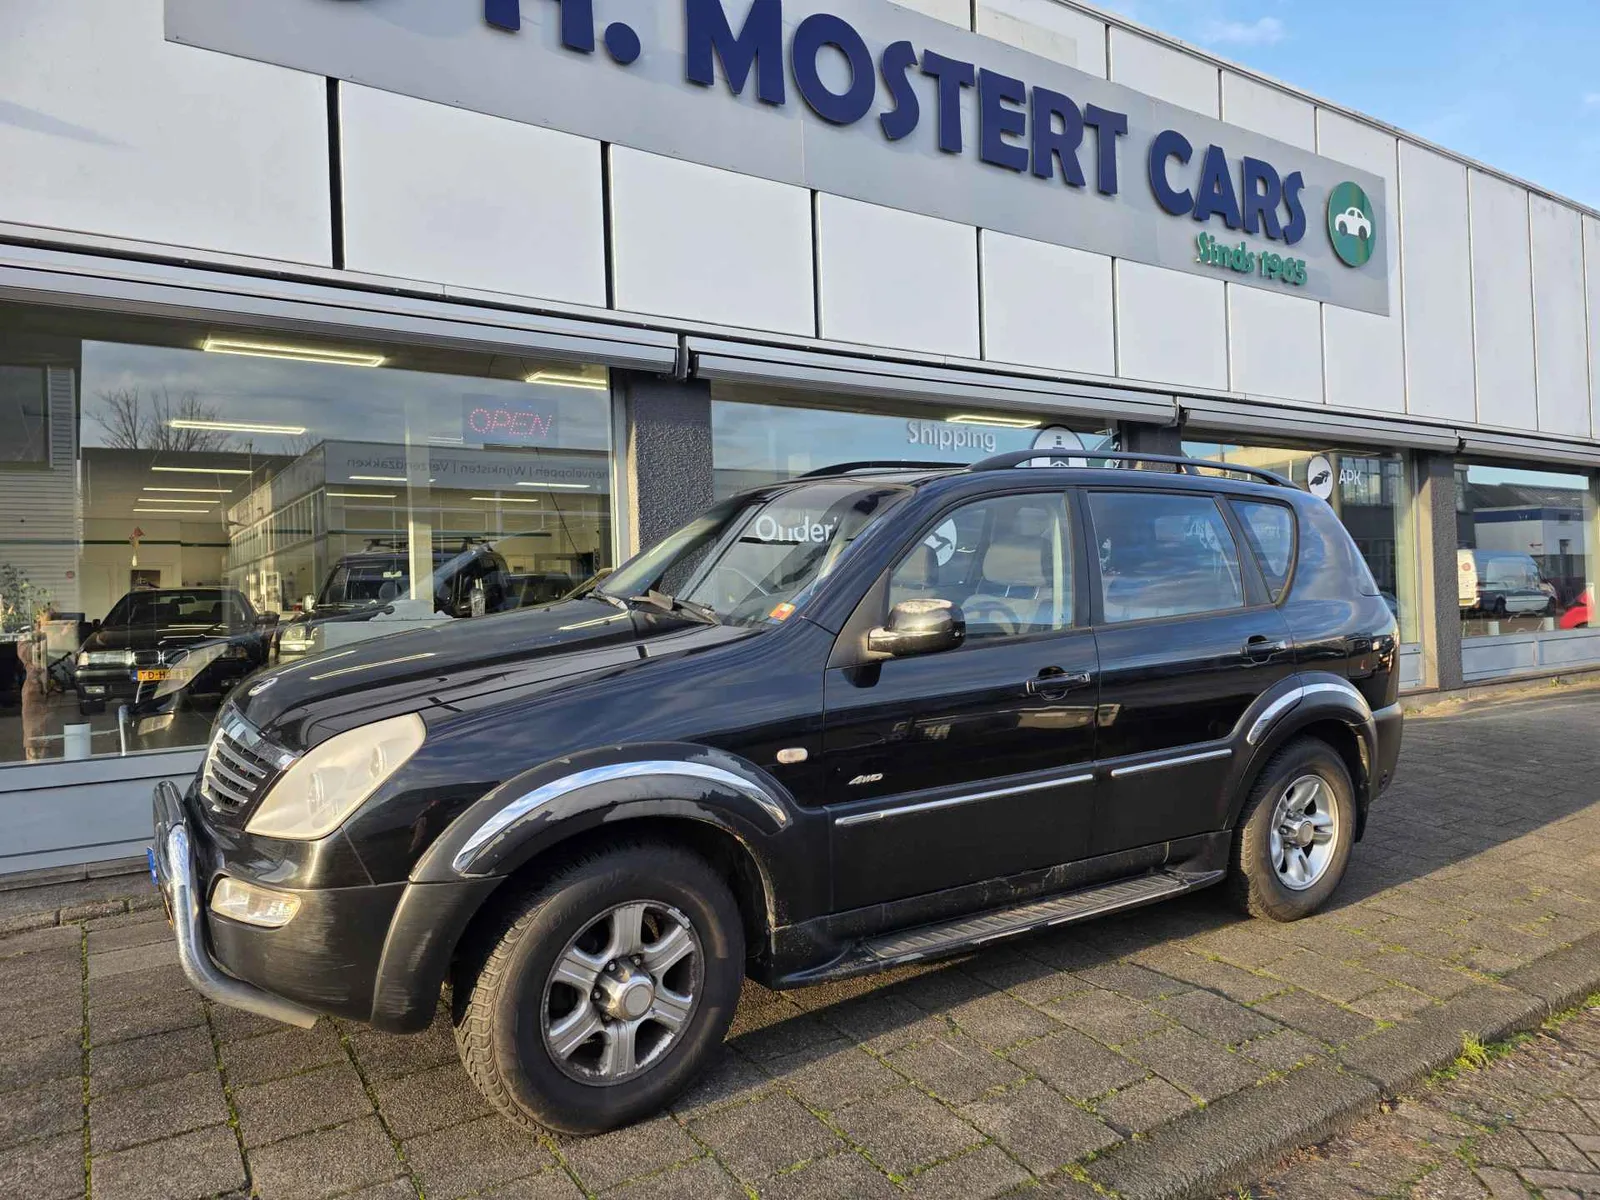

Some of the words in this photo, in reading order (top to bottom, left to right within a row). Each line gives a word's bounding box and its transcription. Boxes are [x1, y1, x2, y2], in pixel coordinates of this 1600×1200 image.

[686, 0, 1128, 195] MOSTERT
[1149, 130, 1307, 246] CARS
[1197, 231, 1255, 273] Sinds
[1261, 251, 1307, 286] 1965
[469, 408, 553, 438] OPEN
[907, 420, 996, 453] Shipping
[1338, 468, 1361, 486] APK
[755, 514, 837, 542] Onder
